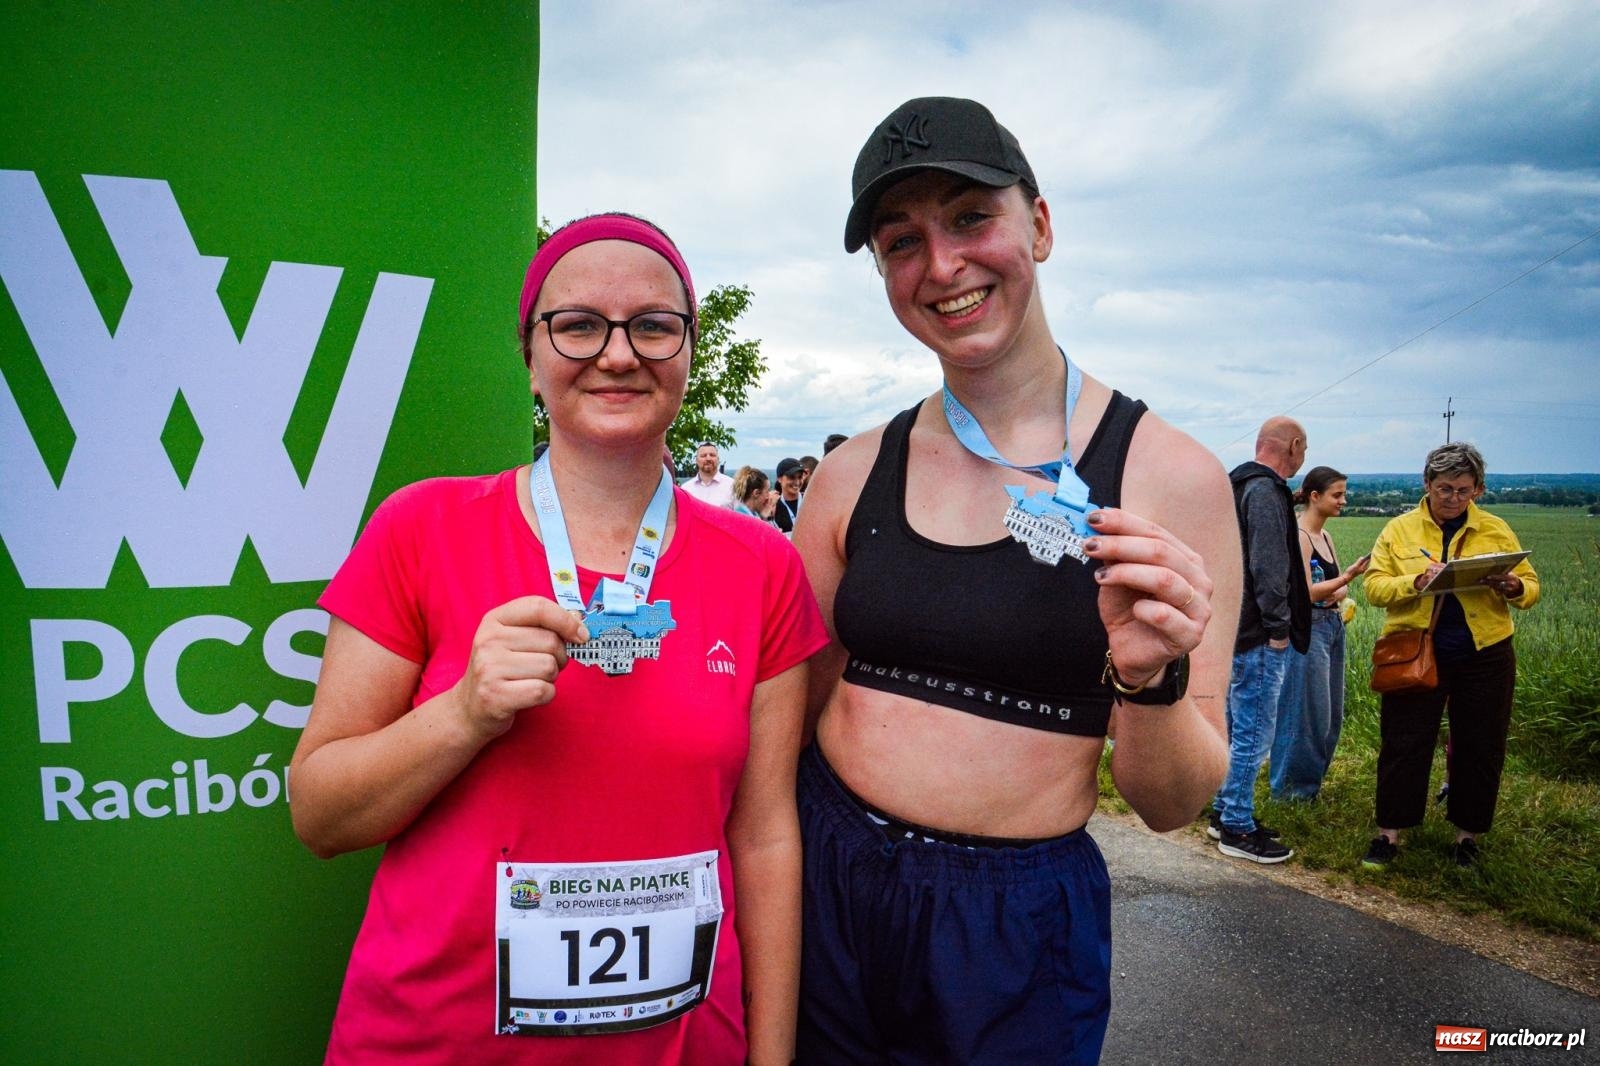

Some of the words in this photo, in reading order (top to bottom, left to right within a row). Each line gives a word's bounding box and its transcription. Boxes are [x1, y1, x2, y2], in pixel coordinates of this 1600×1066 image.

[30, 608, 331, 744] PCS
[40, 753, 290, 821] Racibó
[549, 879, 593, 895] BIEG
[597, 877, 625, 893] NA
[630, 870, 690, 893] PIĄTKĘ
[556, 900, 570, 909] PO
[572, 898, 621, 909] POWIECIE
[623, 892, 685, 907] RACIBORSKIM
[560, 925, 650, 987] 121
